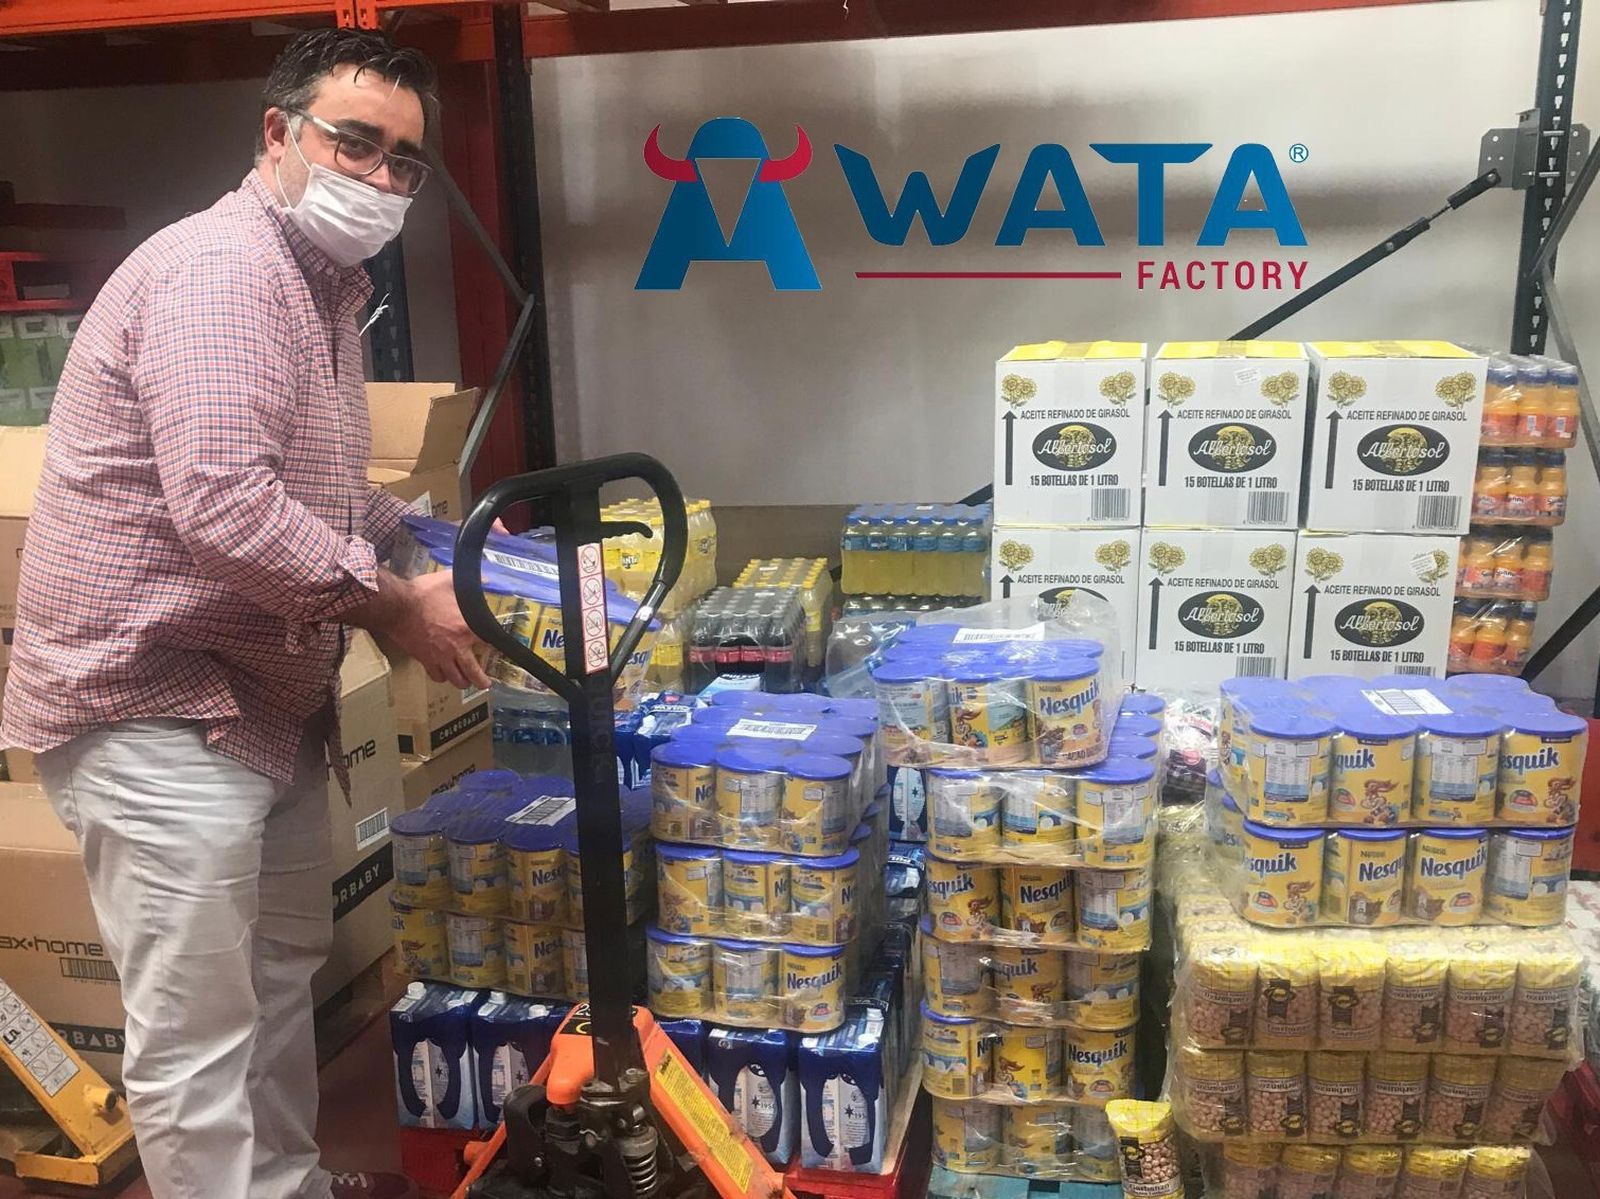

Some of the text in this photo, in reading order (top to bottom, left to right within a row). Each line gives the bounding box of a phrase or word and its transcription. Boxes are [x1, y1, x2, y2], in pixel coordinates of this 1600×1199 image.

[1020, 408, 1130, 420] ACEITE REFINADO DE GIRASOL
[1177, 409, 1292, 419] ACEITE REFINADO DE GIRASOL
[1346, 410, 1467, 421] ACEITE REFINADO DE GIRASOL
[1030, 474, 1040, 486] 15
[1041, 474, 1077, 486] BOTELLAS
[1079, 474, 1089, 486] DE
[1097, 474, 1119, 486] LITRO
[1184, 476, 1195, 488] 15
[1196, 476, 1234, 488] BOTELLAS
[1236, 476, 1246, 488] DE
[1255, 477, 1278, 489] LITRO
[1353, 479, 1363, 491] 15
[1364, 479, 1405, 492] BOTELLAS
[1406, 480, 1417, 492] DE
[1426, 480, 1450, 493] LITRO
[1017, 574, 1125, 584] ACEITE REFINADO DE GIRASOL
[1167, 577, 1279, 589] ACEITE REFINADO DE GIRASOL
[1324, 585, 1441, 597] ACEITE REFINADO DE GIRASOL
[1174, 641, 1184, 652] 15
[1185, 641, 1223, 653] BOTELLAS
[1224, 642, 1234, 654] DE
[1243, 643, 1265, 654] LITRO
[1330, 650, 1341, 661] 15
[1342, 650, 1381, 662] BOTELLAS
[1382, 651, 1392, 663] DE
[1402, 651, 1424, 664] LITRO
[1040, 679, 1100, 715] Nesquik
[787, 962, 842, 990] Nesquik
[1068, 1041, 1127, 1066] Nesquik
